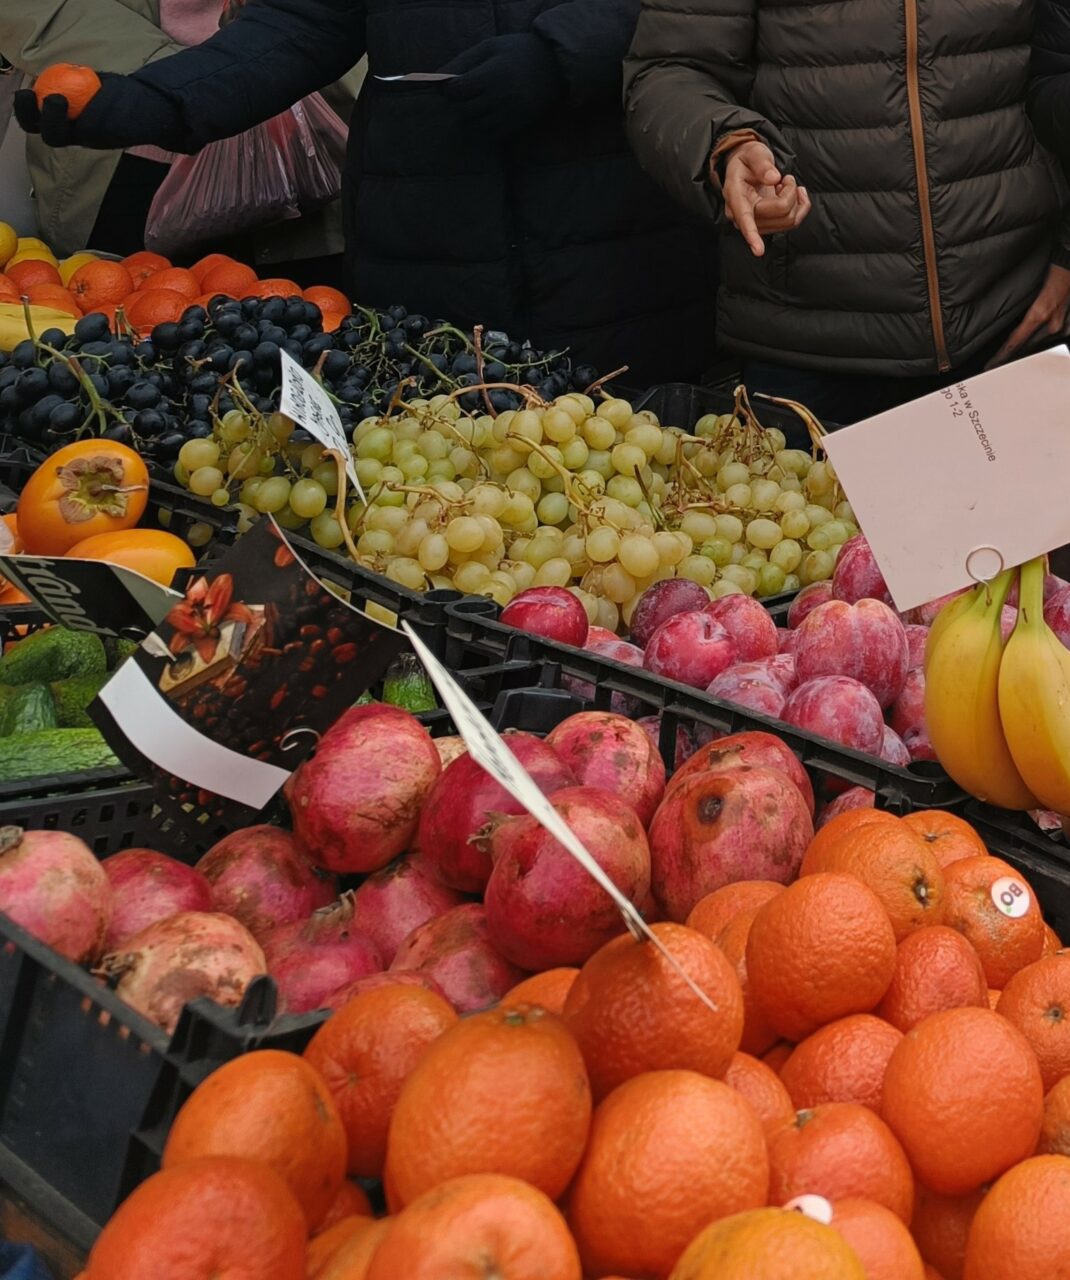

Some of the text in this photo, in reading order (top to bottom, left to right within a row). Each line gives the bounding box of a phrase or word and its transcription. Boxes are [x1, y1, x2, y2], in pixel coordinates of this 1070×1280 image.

[949, 401, 964, 418] 1-2
[963, 400, 973, 410] w
[968, 410, 996, 462] Szczecinie
